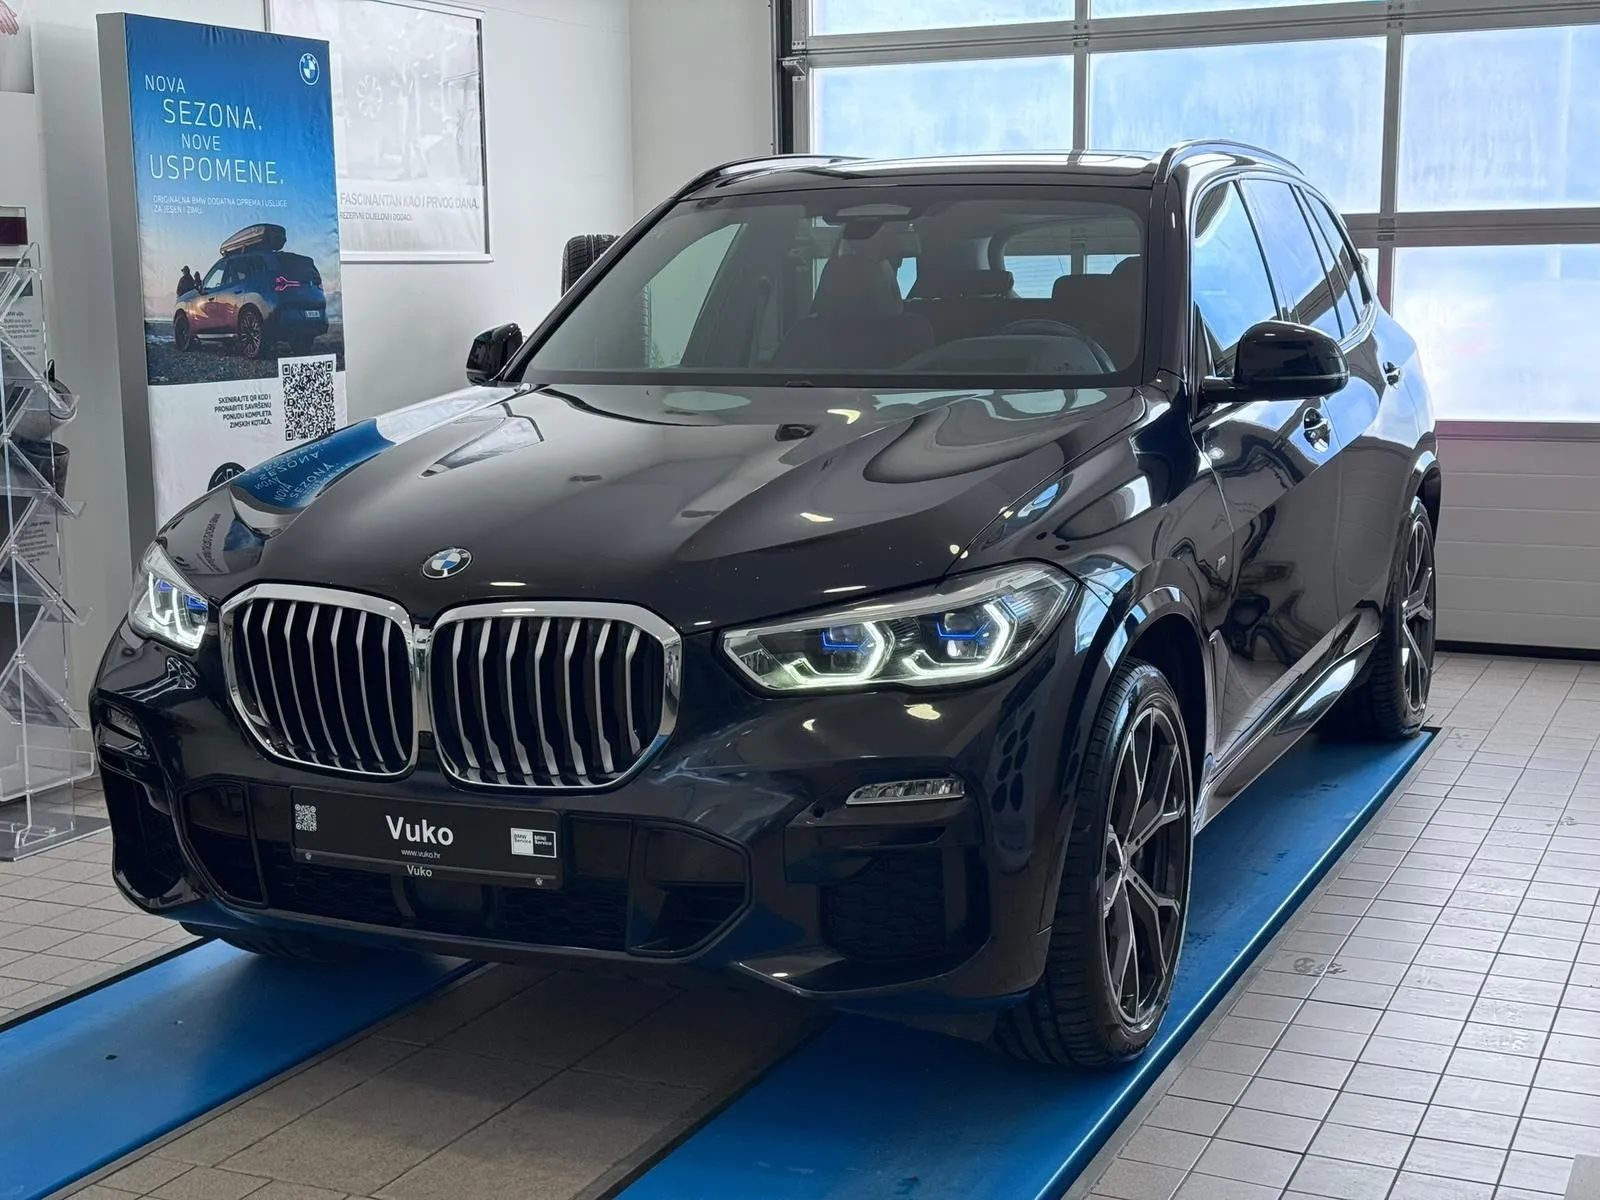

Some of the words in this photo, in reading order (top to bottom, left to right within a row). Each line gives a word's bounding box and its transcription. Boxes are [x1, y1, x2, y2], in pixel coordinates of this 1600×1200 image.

[144, 74, 186, 94] NOVA
[163, 98, 263, 131] SEZONA.
[181, 132, 221, 151] NOVE
[149, 154, 284, 185] USPOMENE.
[218, 395, 249, 404] SKENIRAJTE
[249, 394, 258, 402] QR
[258, 393, 269, 401] KOD
[223, 412, 245, 421] PONUDU
[385, 815, 454, 846] Vuko
[401, 849, 441, 859] www.vuko.hr
[407, 864, 433, 877] Vuko
